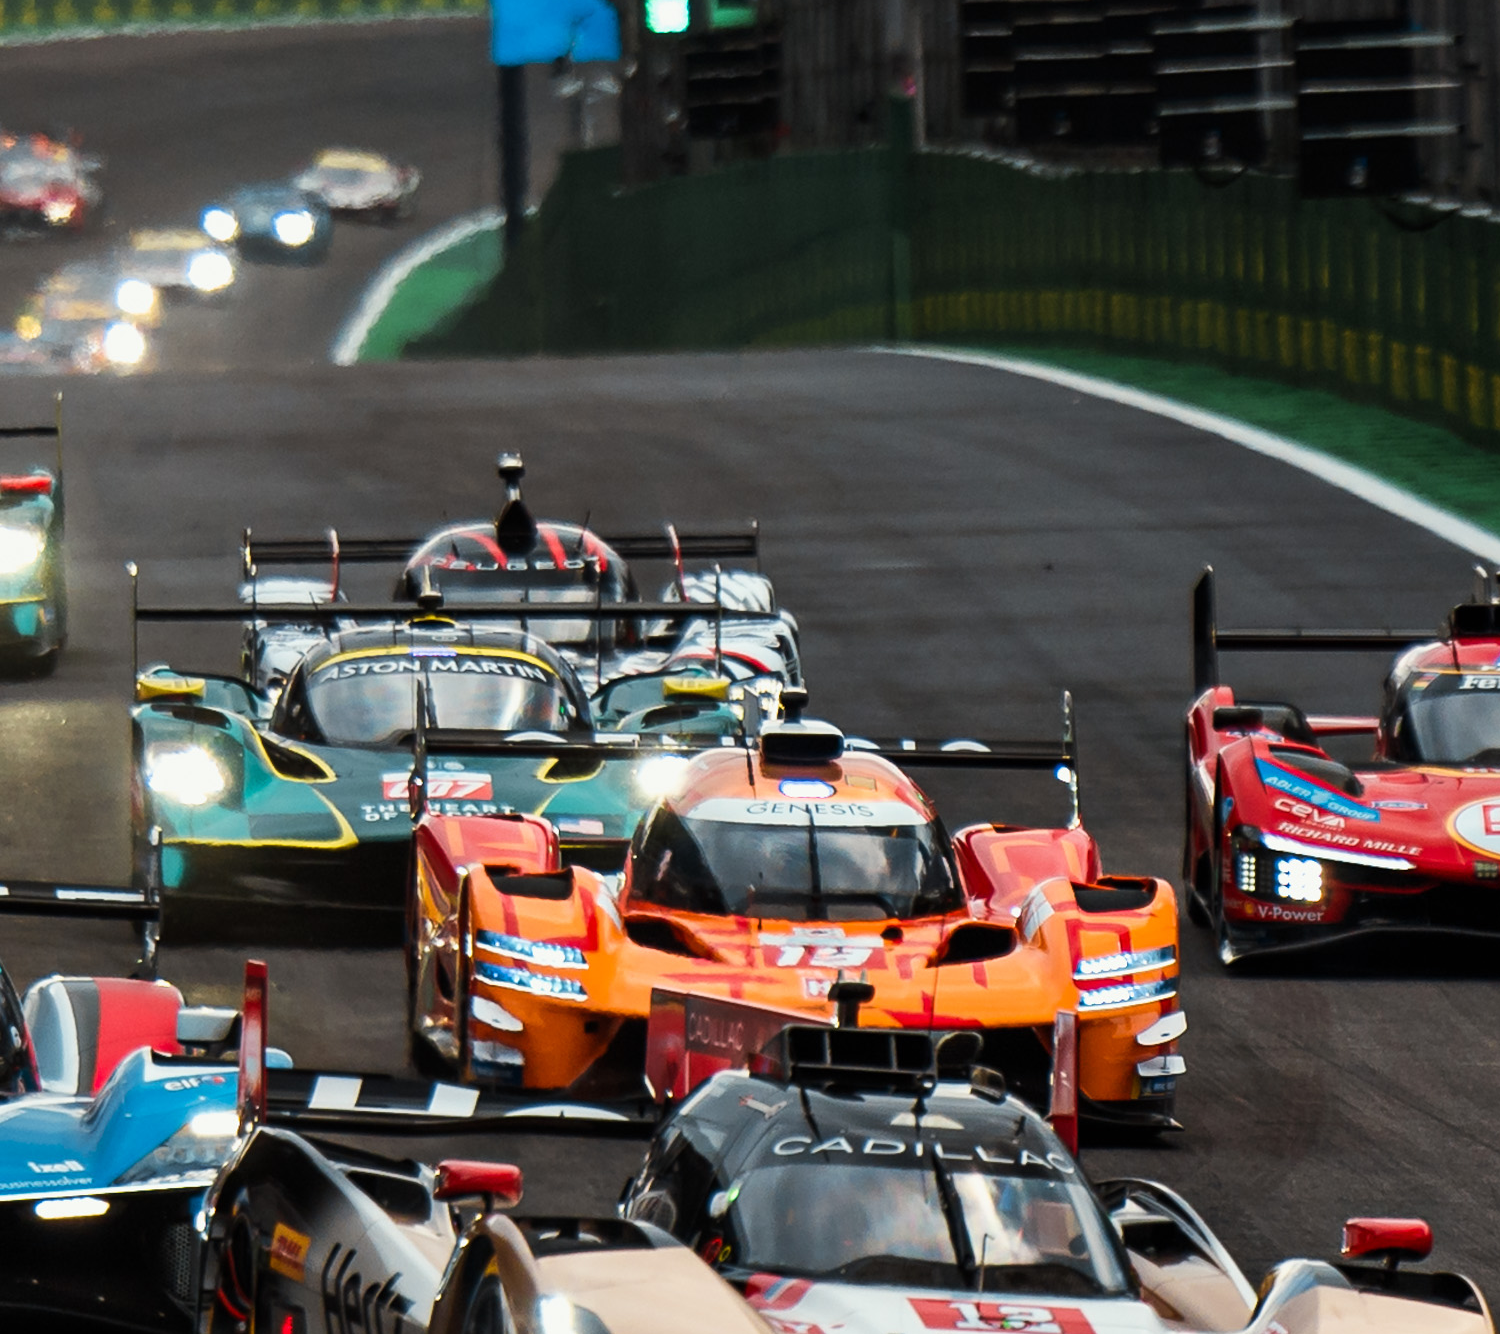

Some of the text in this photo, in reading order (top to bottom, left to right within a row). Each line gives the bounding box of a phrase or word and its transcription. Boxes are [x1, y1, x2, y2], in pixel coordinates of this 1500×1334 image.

[320, 658, 547, 684] ASTON MARTIN
[745, 801, 875, 820] GENESIS
[1326, 801, 1377, 822] GROUP
[1277, 821, 1360, 848] RICHARD
[1362, 838, 1424, 857] MILLE
[1257, 904, 1325, 923] V-Power
[163, 1076, 201, 1092] elf
[772, 1135, 1076, 1175] CADILLAC
